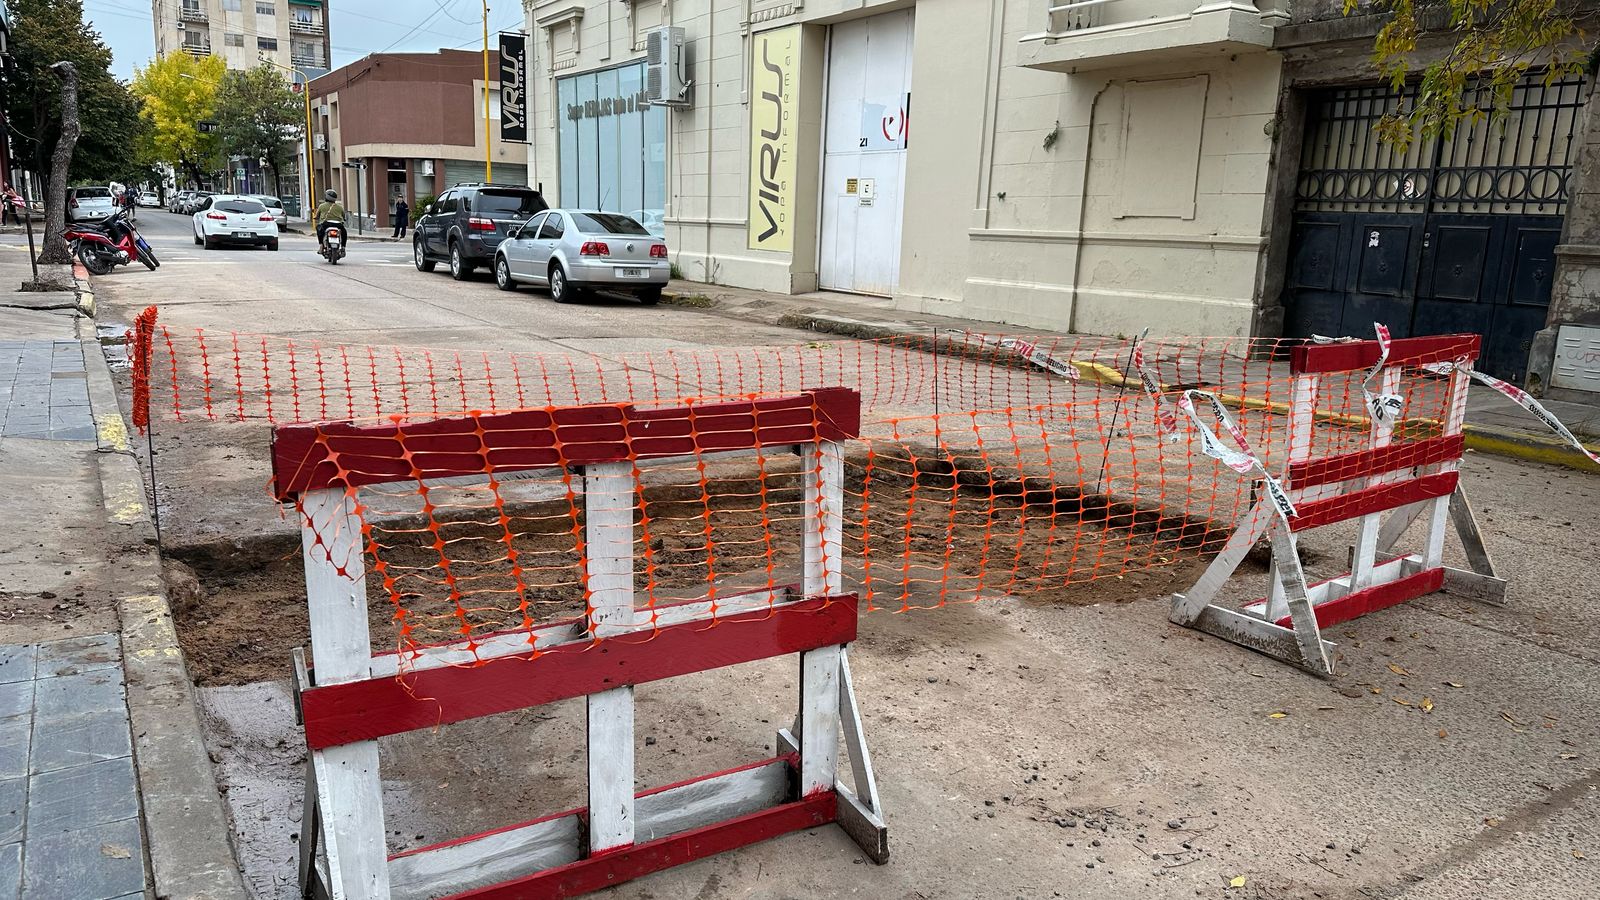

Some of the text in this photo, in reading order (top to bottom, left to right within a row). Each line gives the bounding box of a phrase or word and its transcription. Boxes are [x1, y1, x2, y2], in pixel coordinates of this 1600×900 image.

[502, 44, 519, 129] VIRUS
[758, 38, 783, 242] VIRUS
[860, 138, 868, 147] 21
